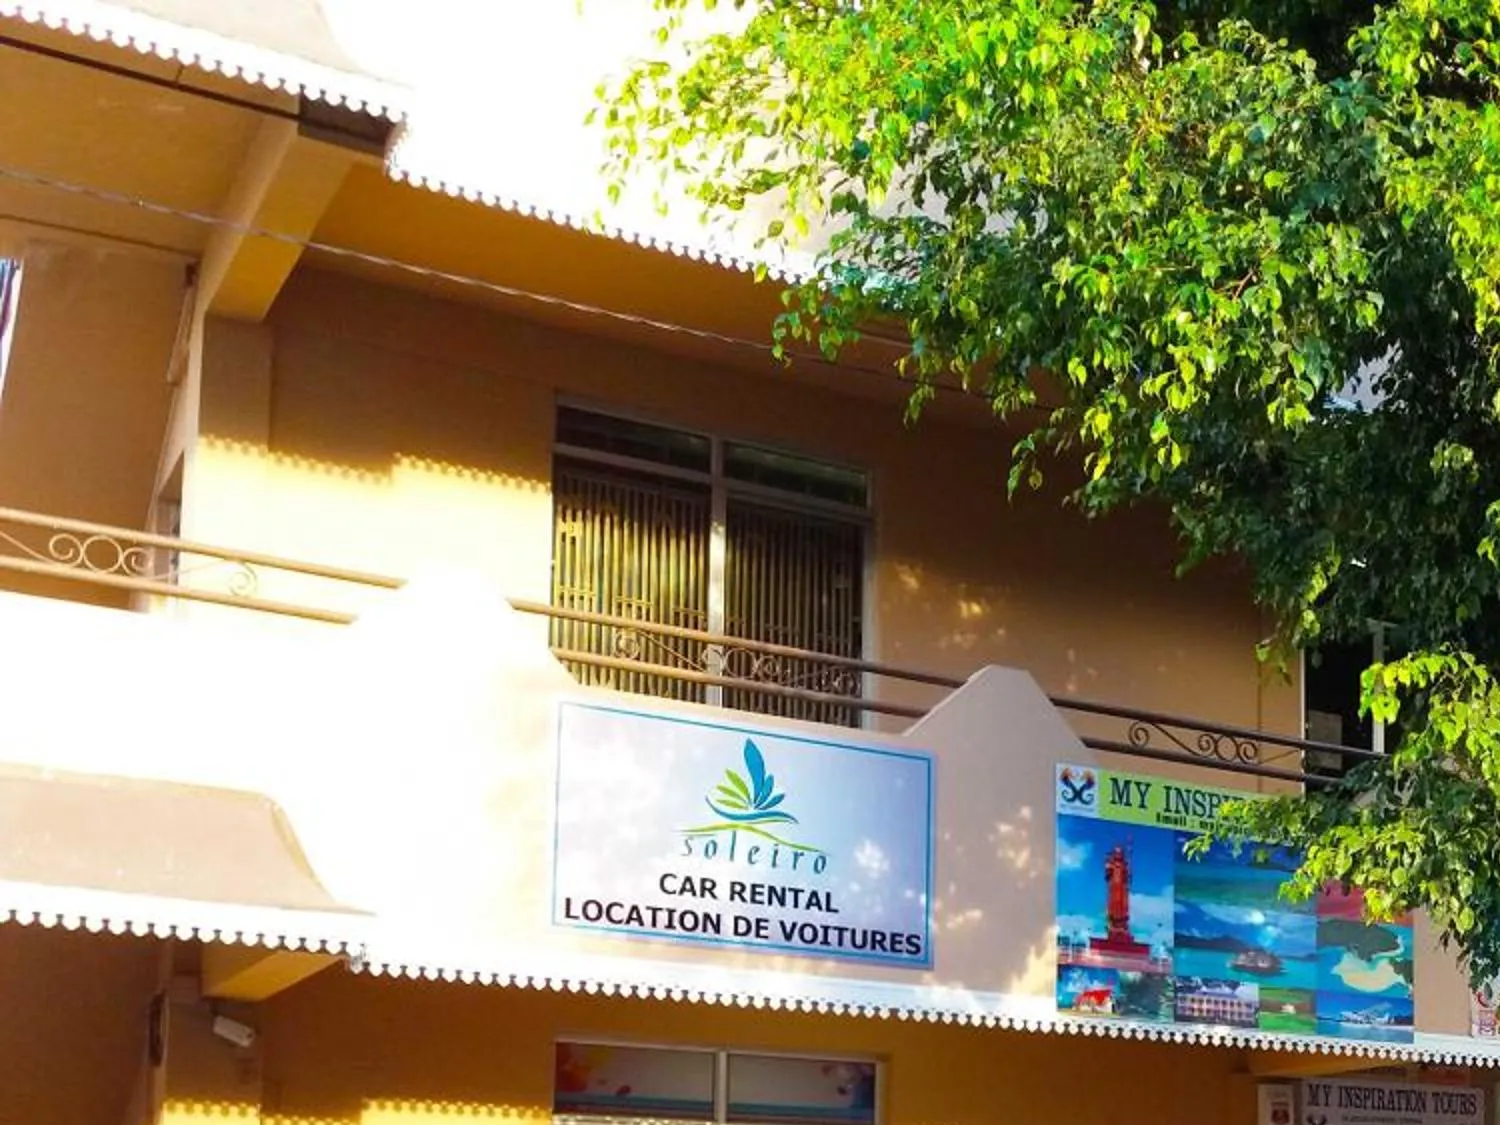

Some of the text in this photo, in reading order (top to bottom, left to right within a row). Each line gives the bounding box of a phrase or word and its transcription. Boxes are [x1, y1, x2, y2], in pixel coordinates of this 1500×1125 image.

[1109, 777, 1152, 809] MY
[681, 830, 827, 874] soleiro
[659, 873, 839, 913] CAR RENTAL
[564, 897, 922, 955] LOCATION DE VOITURES
[1307, 1083, 1332, 1107] MY
[1337, 1085, 1427, 1113] INSPIRATION
[1431, 1091, 1478, 1116] TOURS
